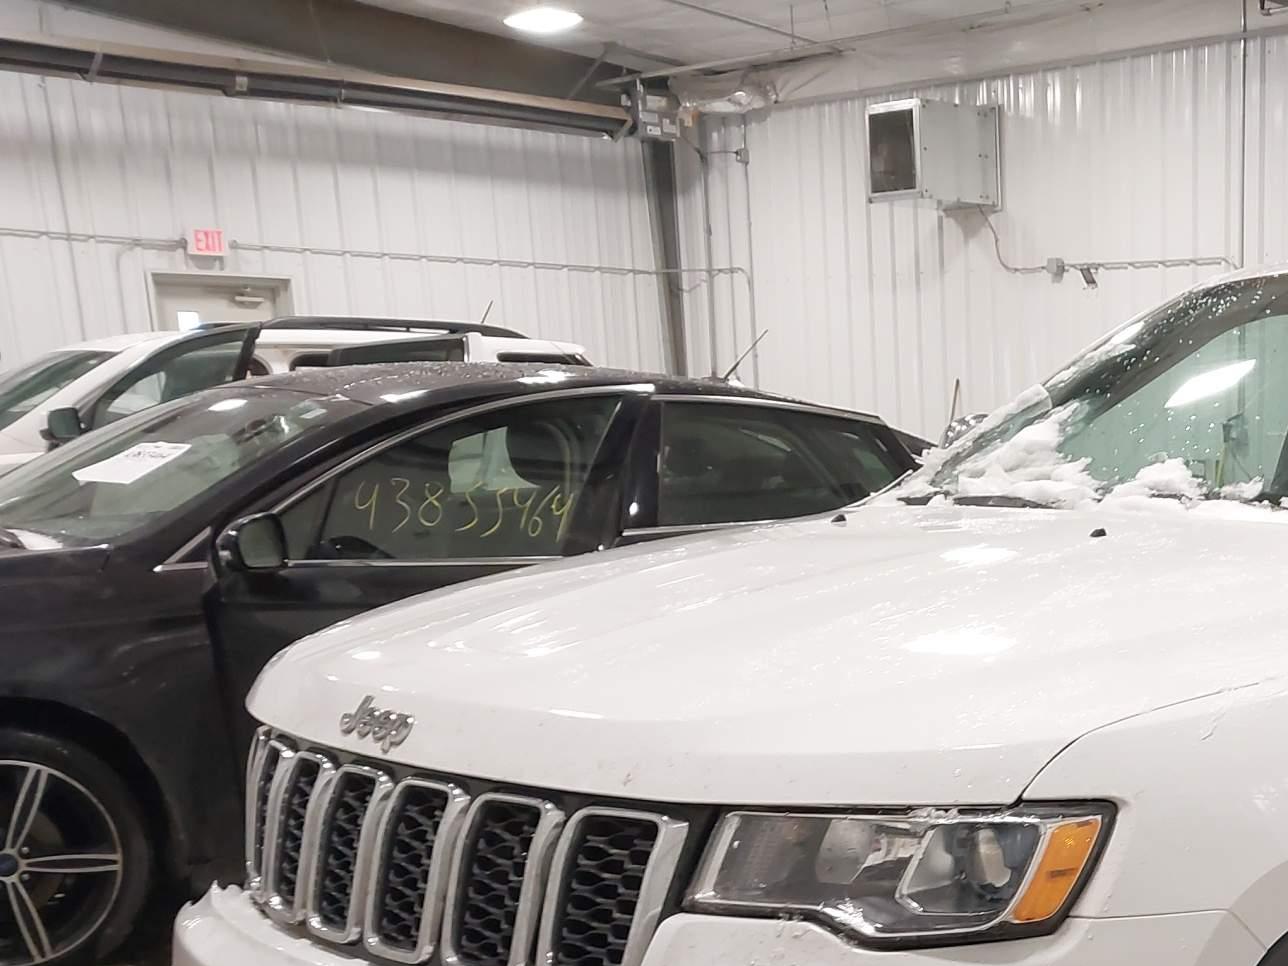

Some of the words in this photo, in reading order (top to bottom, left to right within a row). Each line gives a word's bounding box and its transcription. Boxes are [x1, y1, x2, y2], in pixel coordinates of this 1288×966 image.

[194, 229, 223, 252] EXIT
[355, 477, 574, 543] 43855464
[340, 694, 414, 754] Jeep
